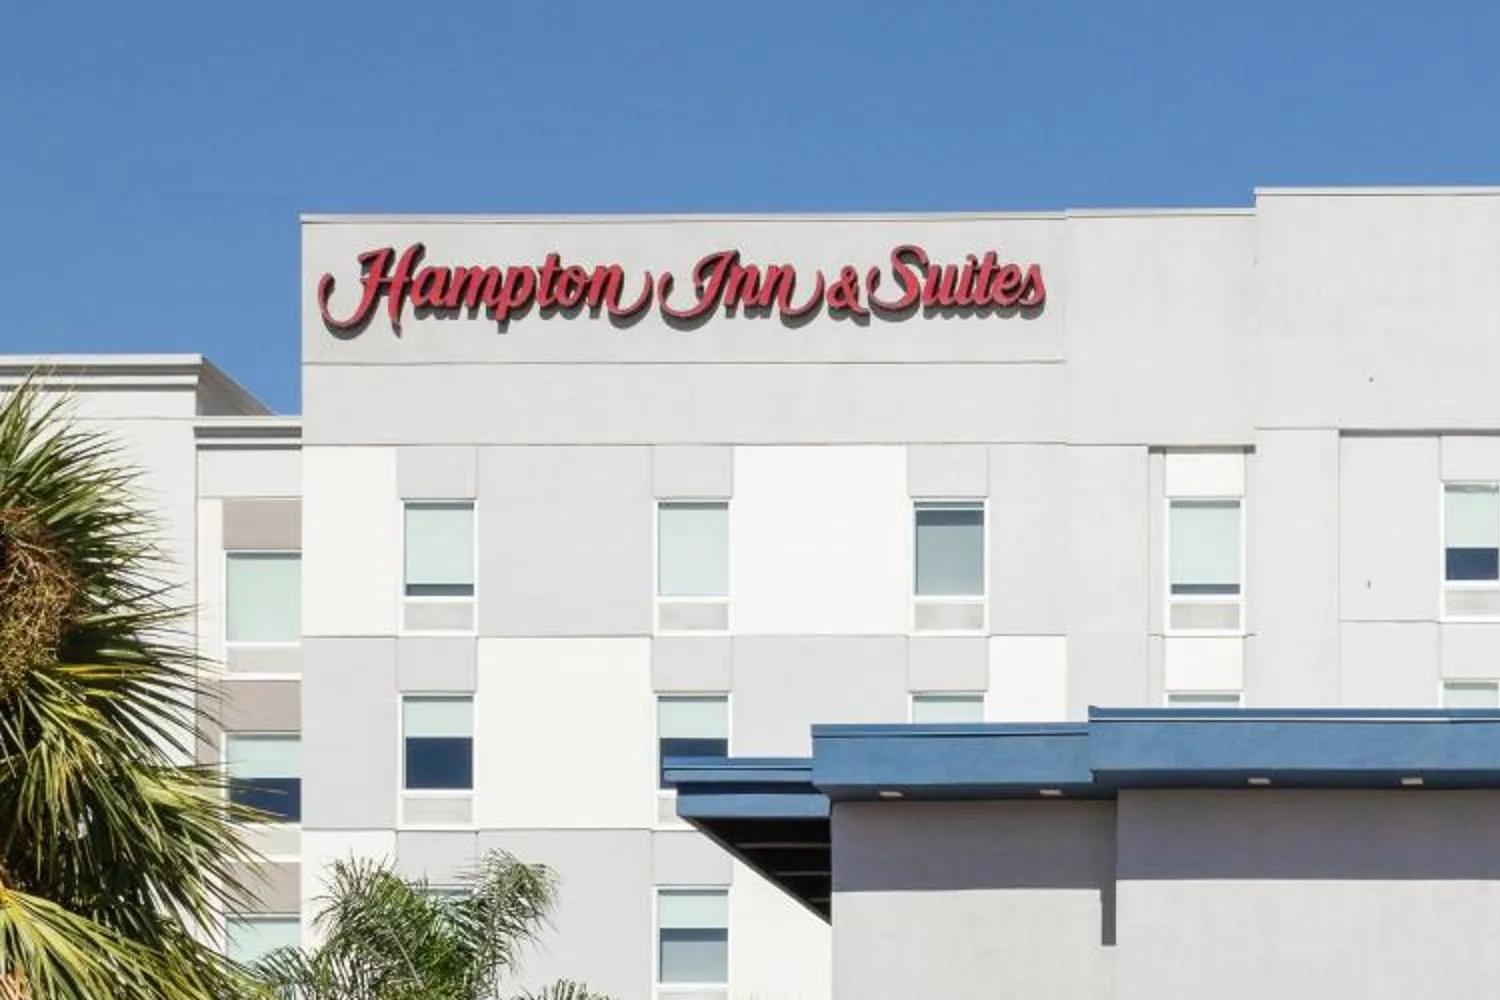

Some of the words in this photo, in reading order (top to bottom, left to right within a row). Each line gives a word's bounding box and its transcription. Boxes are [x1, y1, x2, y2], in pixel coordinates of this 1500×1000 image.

[318, 243, 655, 331] Hampton
[656, 248, 826, 319] Inn
[826, 265, 871, 316] &
[866, 245, 1047, 311] Suites
